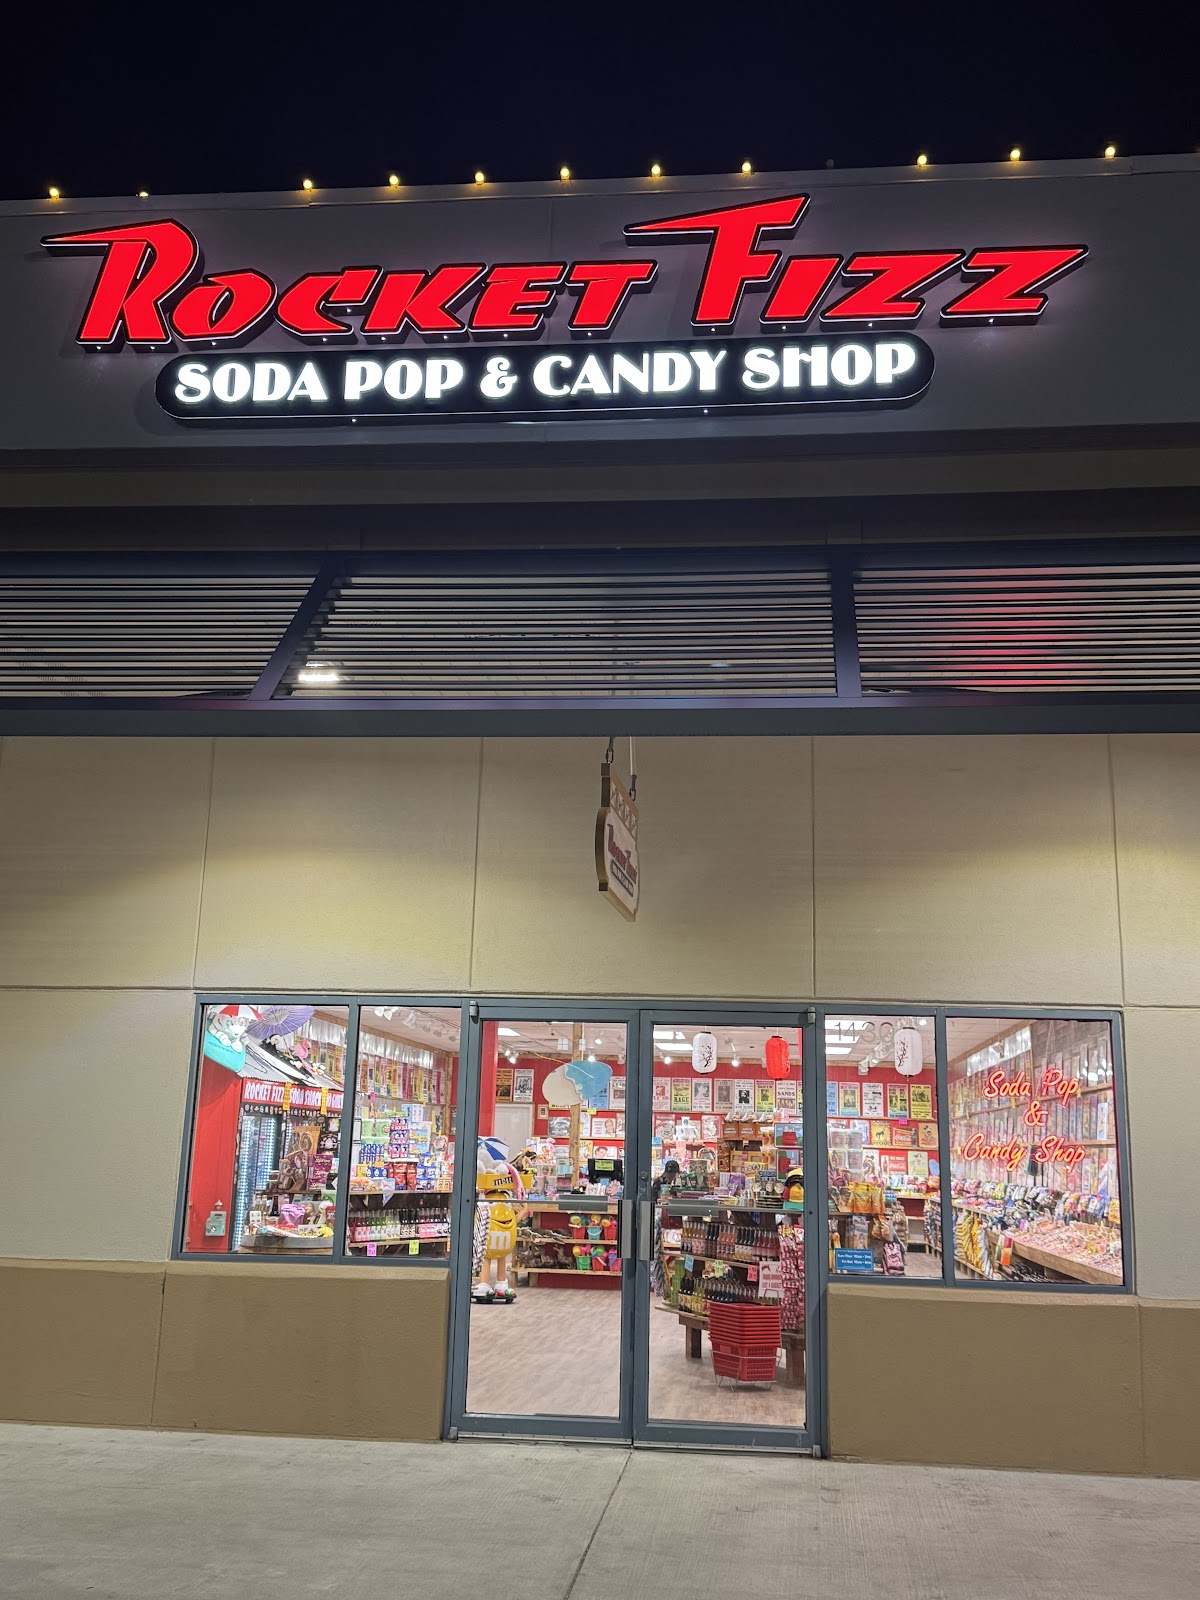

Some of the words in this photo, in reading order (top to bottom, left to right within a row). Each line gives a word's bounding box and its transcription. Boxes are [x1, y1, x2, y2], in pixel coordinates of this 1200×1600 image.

[174, 360, 328, 404] SODA
[344, 357, 464, 401] POP
[480, 356, 518, 399] &
[532, 350, 727, 398] CANDY
[742, 343, 917, 391] SHOP
[834, 1021, 894, 1043] 1430
[245, 1081, 271, 1101] ROCKET
[983, 1068, 1031, 1098] Soda
[1042, 1068, 1079, 1107] Pop
[1023, 1100, 1048, 1127] &
[963, 1132, 1026, 1172] Candy
[1035, 1135, 1086, 1174] Shop
[489, 1230, 511, 1250] m
